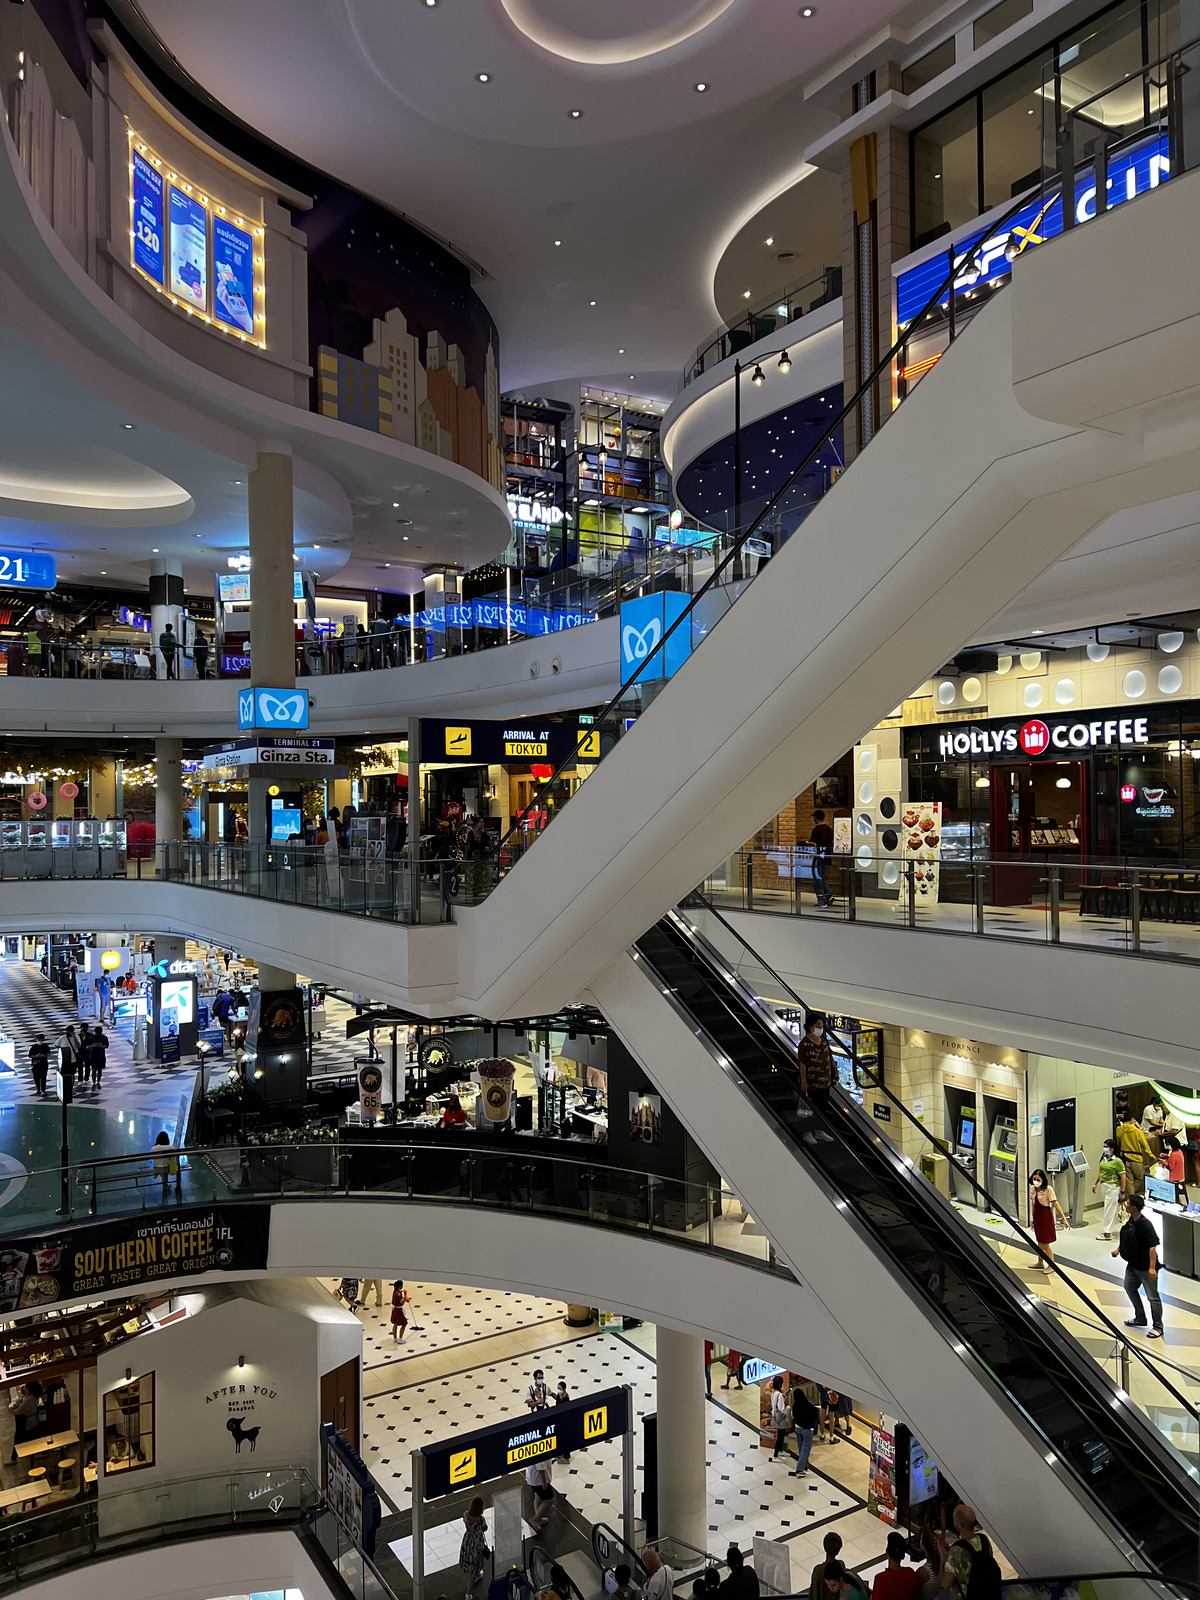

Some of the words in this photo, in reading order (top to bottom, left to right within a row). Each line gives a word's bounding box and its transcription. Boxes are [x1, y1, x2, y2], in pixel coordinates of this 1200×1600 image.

[136, 220, 160, 254] 120
[0, 556, 27, 582] 21
[273, 738, 310, 747] TERMINAL
[503, 730, 536, 741] ARRIVAL
[539, 731, 549, 741] AT
[583, 733, 594, 753] 2
[939, 728, 1018, 756] HOLLYS
[1051, 717, 1149, 748] COFFEE
[260, 749, 300, 763] Ginza
[304, 751, 332, 763] Sta.
[509, 743, 543, 755] TOKYO
[215, 755, 226, 767] Ginza
[226, 753, 241, 766] Station
[450, 876, 457, 894] 2
[169, 959, 198, 974] dtac
[941, 1040, 981, 1054] FLORENCE
[74, 1236, 157, 1279] SOUTHERN
[161, 1227, 214, 1261] COFFEE
[215, 1227, 234, 1240] 1FL
[73, 1277, 105, 1293] GREAT
[110, 1268, 141, 1285] TASTE
[146, 1261, 177, 1277] GREAT
[182, 1253, 215, 1272] ORIGIN
[747, 1361, 758, 1379] M
[205, 1384, 246, 1404] AFTER
[253, 1384, 277, 1399] YOU
[588, 1411, 603, 1434] M
[508, 1429, 542, 1449] ARRIVAL
[545, 1424, 556, 1436] AT
[511, 1438, 553, 1463] LONDON
